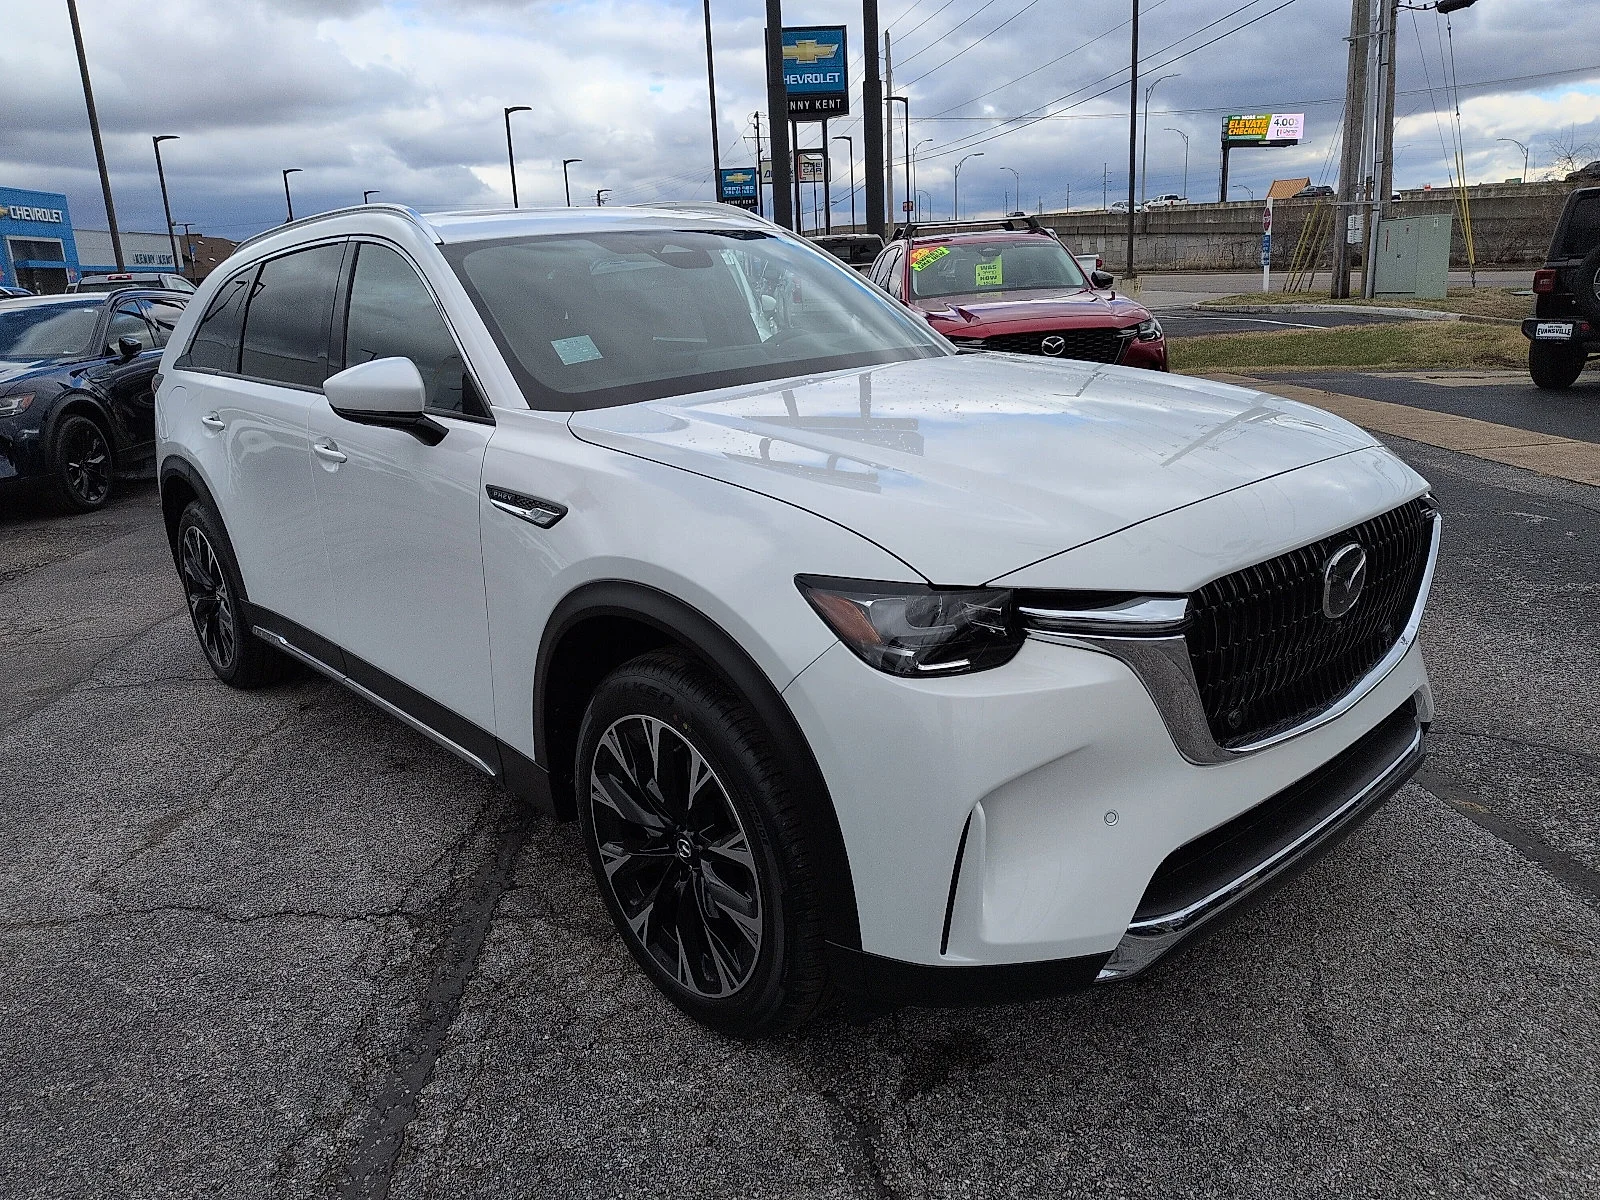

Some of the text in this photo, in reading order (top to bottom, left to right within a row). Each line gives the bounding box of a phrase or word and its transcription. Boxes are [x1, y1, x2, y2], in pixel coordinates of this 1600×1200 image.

[783, 72, 840, 84] HEVROLET
[787, 99, 841, 111] NNY KENT
[9, 205, 63, 222] CHEVROLET
[133, 253, 173, 265] KENNY KENT
[1537, 328, 1572, 336] EVANSVILLE
[494, 491, 513, 501] PHEV
